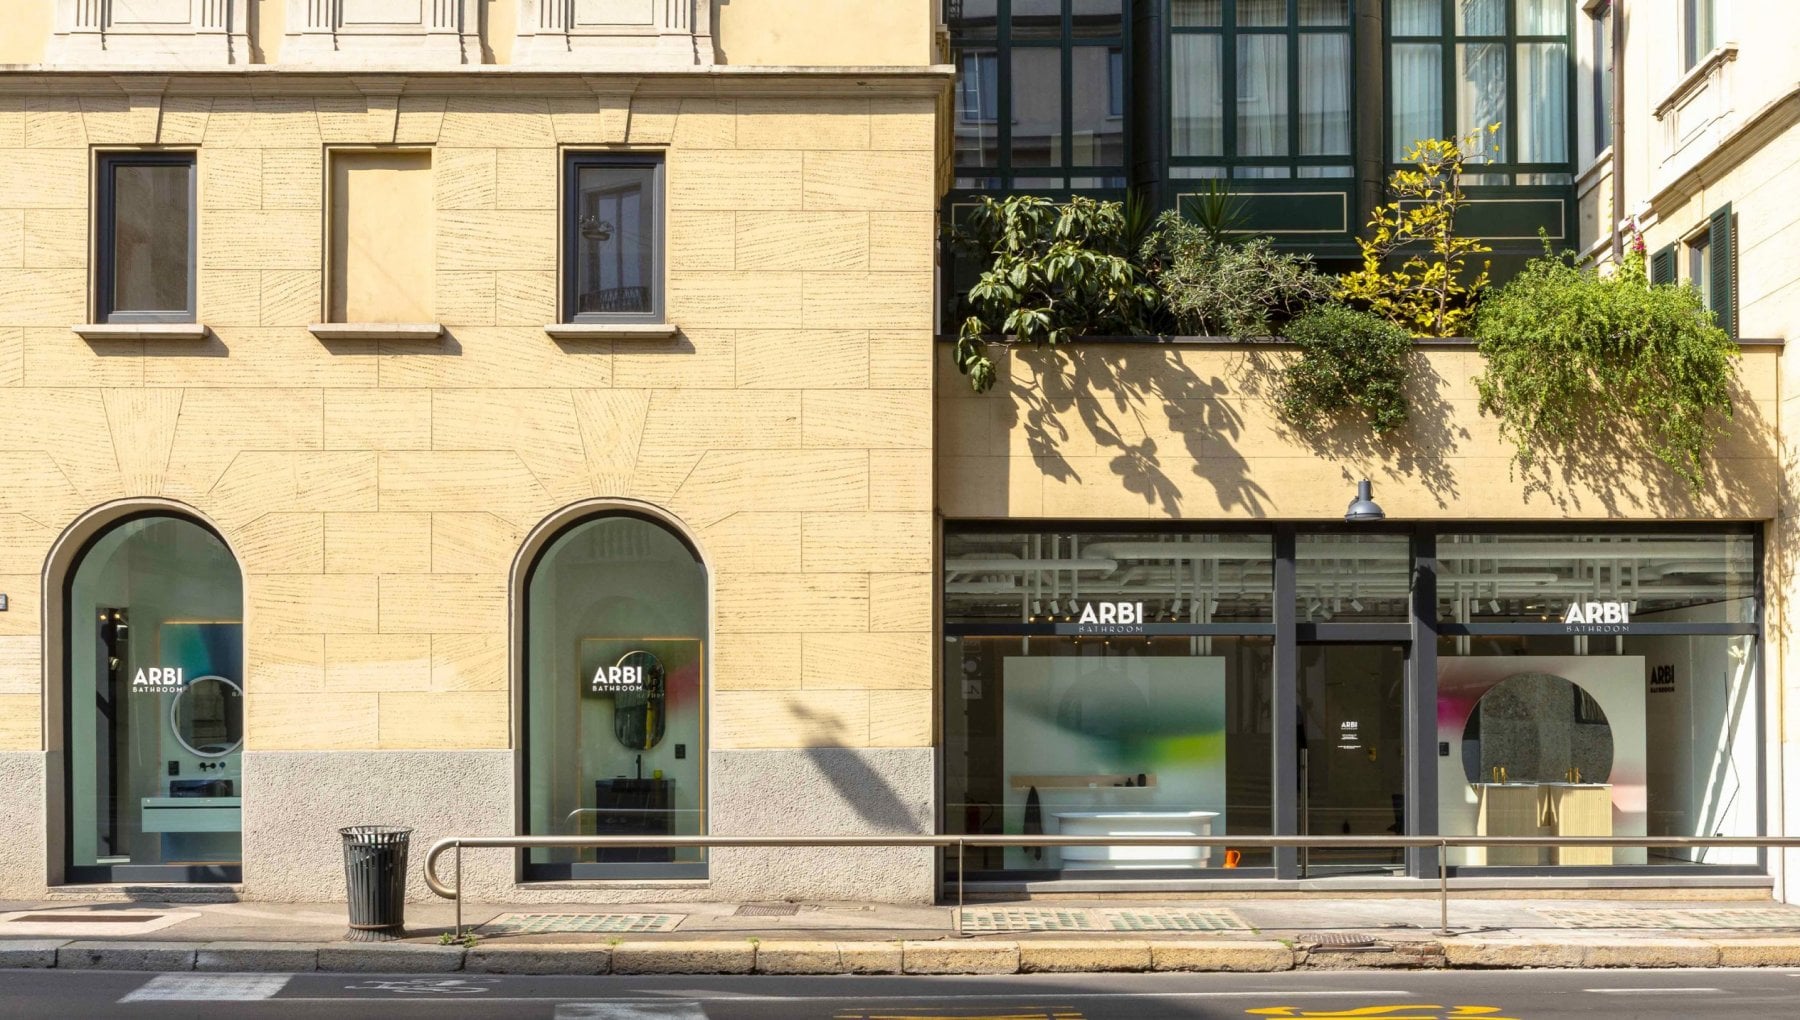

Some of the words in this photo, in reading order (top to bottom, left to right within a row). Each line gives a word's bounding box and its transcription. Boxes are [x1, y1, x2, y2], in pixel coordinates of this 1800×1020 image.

[1078, 602, 1143, 624] ARBI
[1565, 602, 1629, 624] ARBI
[1078, 625, 1143, 633] BATHROOM
[1566, 625, 1630, 633] BATHROOM
[132, 667, 183, 685] ARBI
[592, 666, 642, 684] ARBI
[1650, 664, 1675, 685] ARBI
